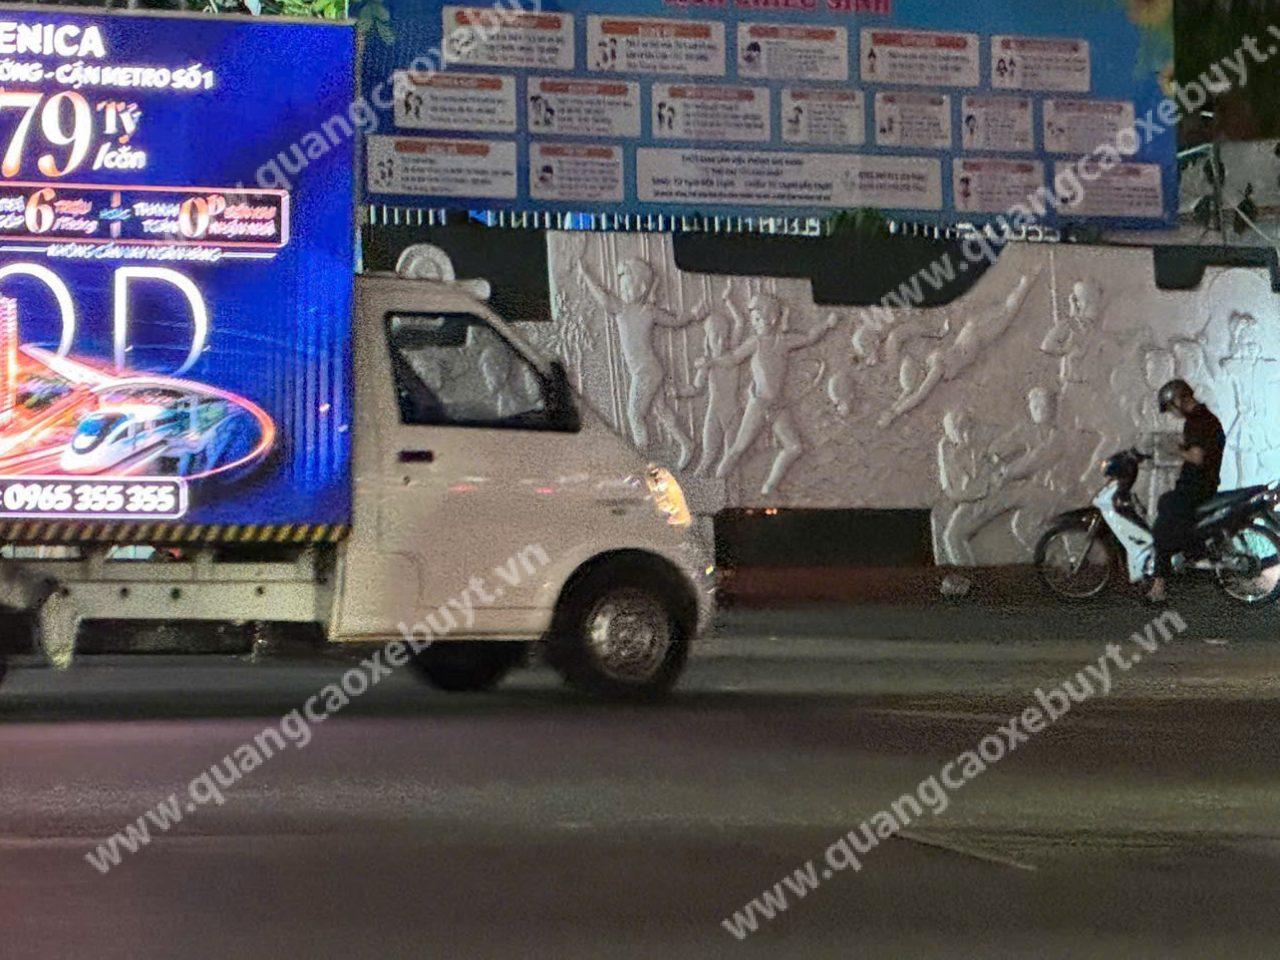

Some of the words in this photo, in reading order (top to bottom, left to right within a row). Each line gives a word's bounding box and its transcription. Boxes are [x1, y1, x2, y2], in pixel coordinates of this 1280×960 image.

[101, 65, 171, 88] METRO
[24, 187, 56, 234] 6
[3, 483, 73, 511] 0965
[74, 484, 125, 513] 355
[125, 485, 177, 513] 355
